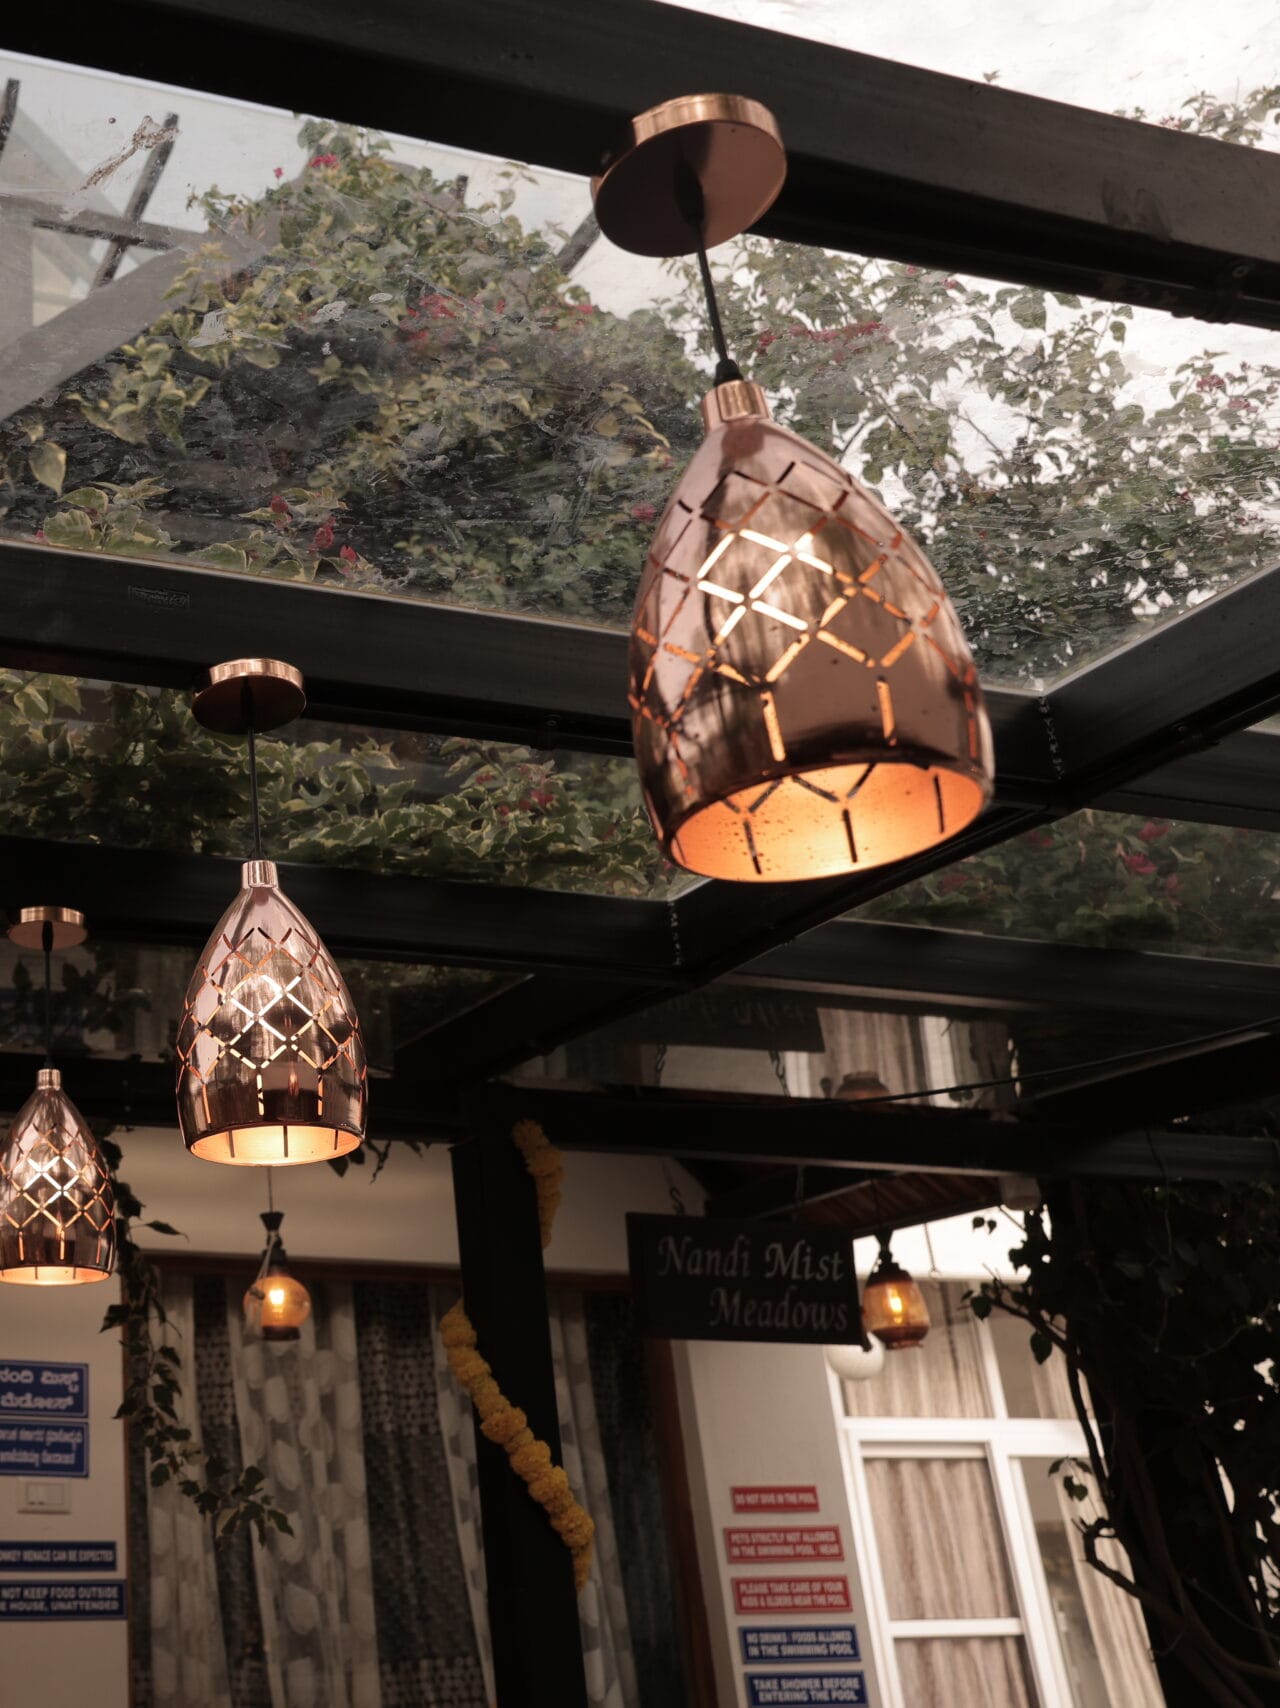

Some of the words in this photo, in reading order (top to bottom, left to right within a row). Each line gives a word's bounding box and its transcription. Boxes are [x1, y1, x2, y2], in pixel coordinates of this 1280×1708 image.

[657, 1233, 751, 1278] Nandi
[765, 1239, 844, 1281] Mist
[708, 1284, 849, 1331] Meadows
[746, 1493, 759, 1505] NOT
[784, 1493, 797, 1504] THE
[799, 1492, 816, 1504] POOL
[731, 1533, 750, 1544] PETS
[751, 1532, 784, 1544] STRICTLY
[786, 1532, 801, 1543] NOT
[803, 1531, 836, 1542] ALLOWED
[23, 1550, 52, 1562] MENACE
[53, 1550, 66, 1562] CAN
[68, 1550, 78, 1562] BE
[79, 1550, 113, 1562] EXPECTED
[731, 1545, 740, 1556] IN
[741, 1545, 755, 1556] THE
[757, 1545, 794, 1556] SWIMMING
[795, 1544, 816, 1555] POOL
[1, 1587, 21, 1599] NOT
[23, 1587, 49, 1599] KEEP
[50, 1587, 76, 1599] FOOD
[78, 1587, 119, 1599] OUTSIDE
[740, 1583, 769, 1594] PLEASE
[770, 1583, 789, 1593] TAKE
[791, 1582, 810, 1593] CARE
[811, 1582, 822, 1593] OF
[823, 1582, 844, 1593] YOUR
[9, 1601, 49, 1612] HOUSE,
[50, 1600, 120, 1612] UNATTENDED
[742, 1596, 759, 1607] KIDS
[767, 1595, 792, 1607] ELDERS
[794, 1595, 812, 1606] NEAR
[813, 1594, 826, 1606] THE
[827, 1594, 847, 1605] POOL
[746, 1632, 758, 1643] NO
[759, 1632, 787, 1643] DRINKS
[792, 1631, 816, 1642] FOODS
[818, 1630, 852, 1642] ALLOWED
[748, 1645, 760, 1657] IN
[761, 1645, 780, 1656] THE
[780, 1644, 829, 1656] SWIMMING
[829, 1643, 855, 1655] POOL
[753, 1679, 779, 1690] TAKE
[780, 1678, 822, 1689] SHOWER
[822, 1677, 860, 1689] BEFORE
[759, 1690, 809, 1702] ENTERING
[809, 1690, 830, 1702] THE
[831, 1689, 859, 1701] POOL
